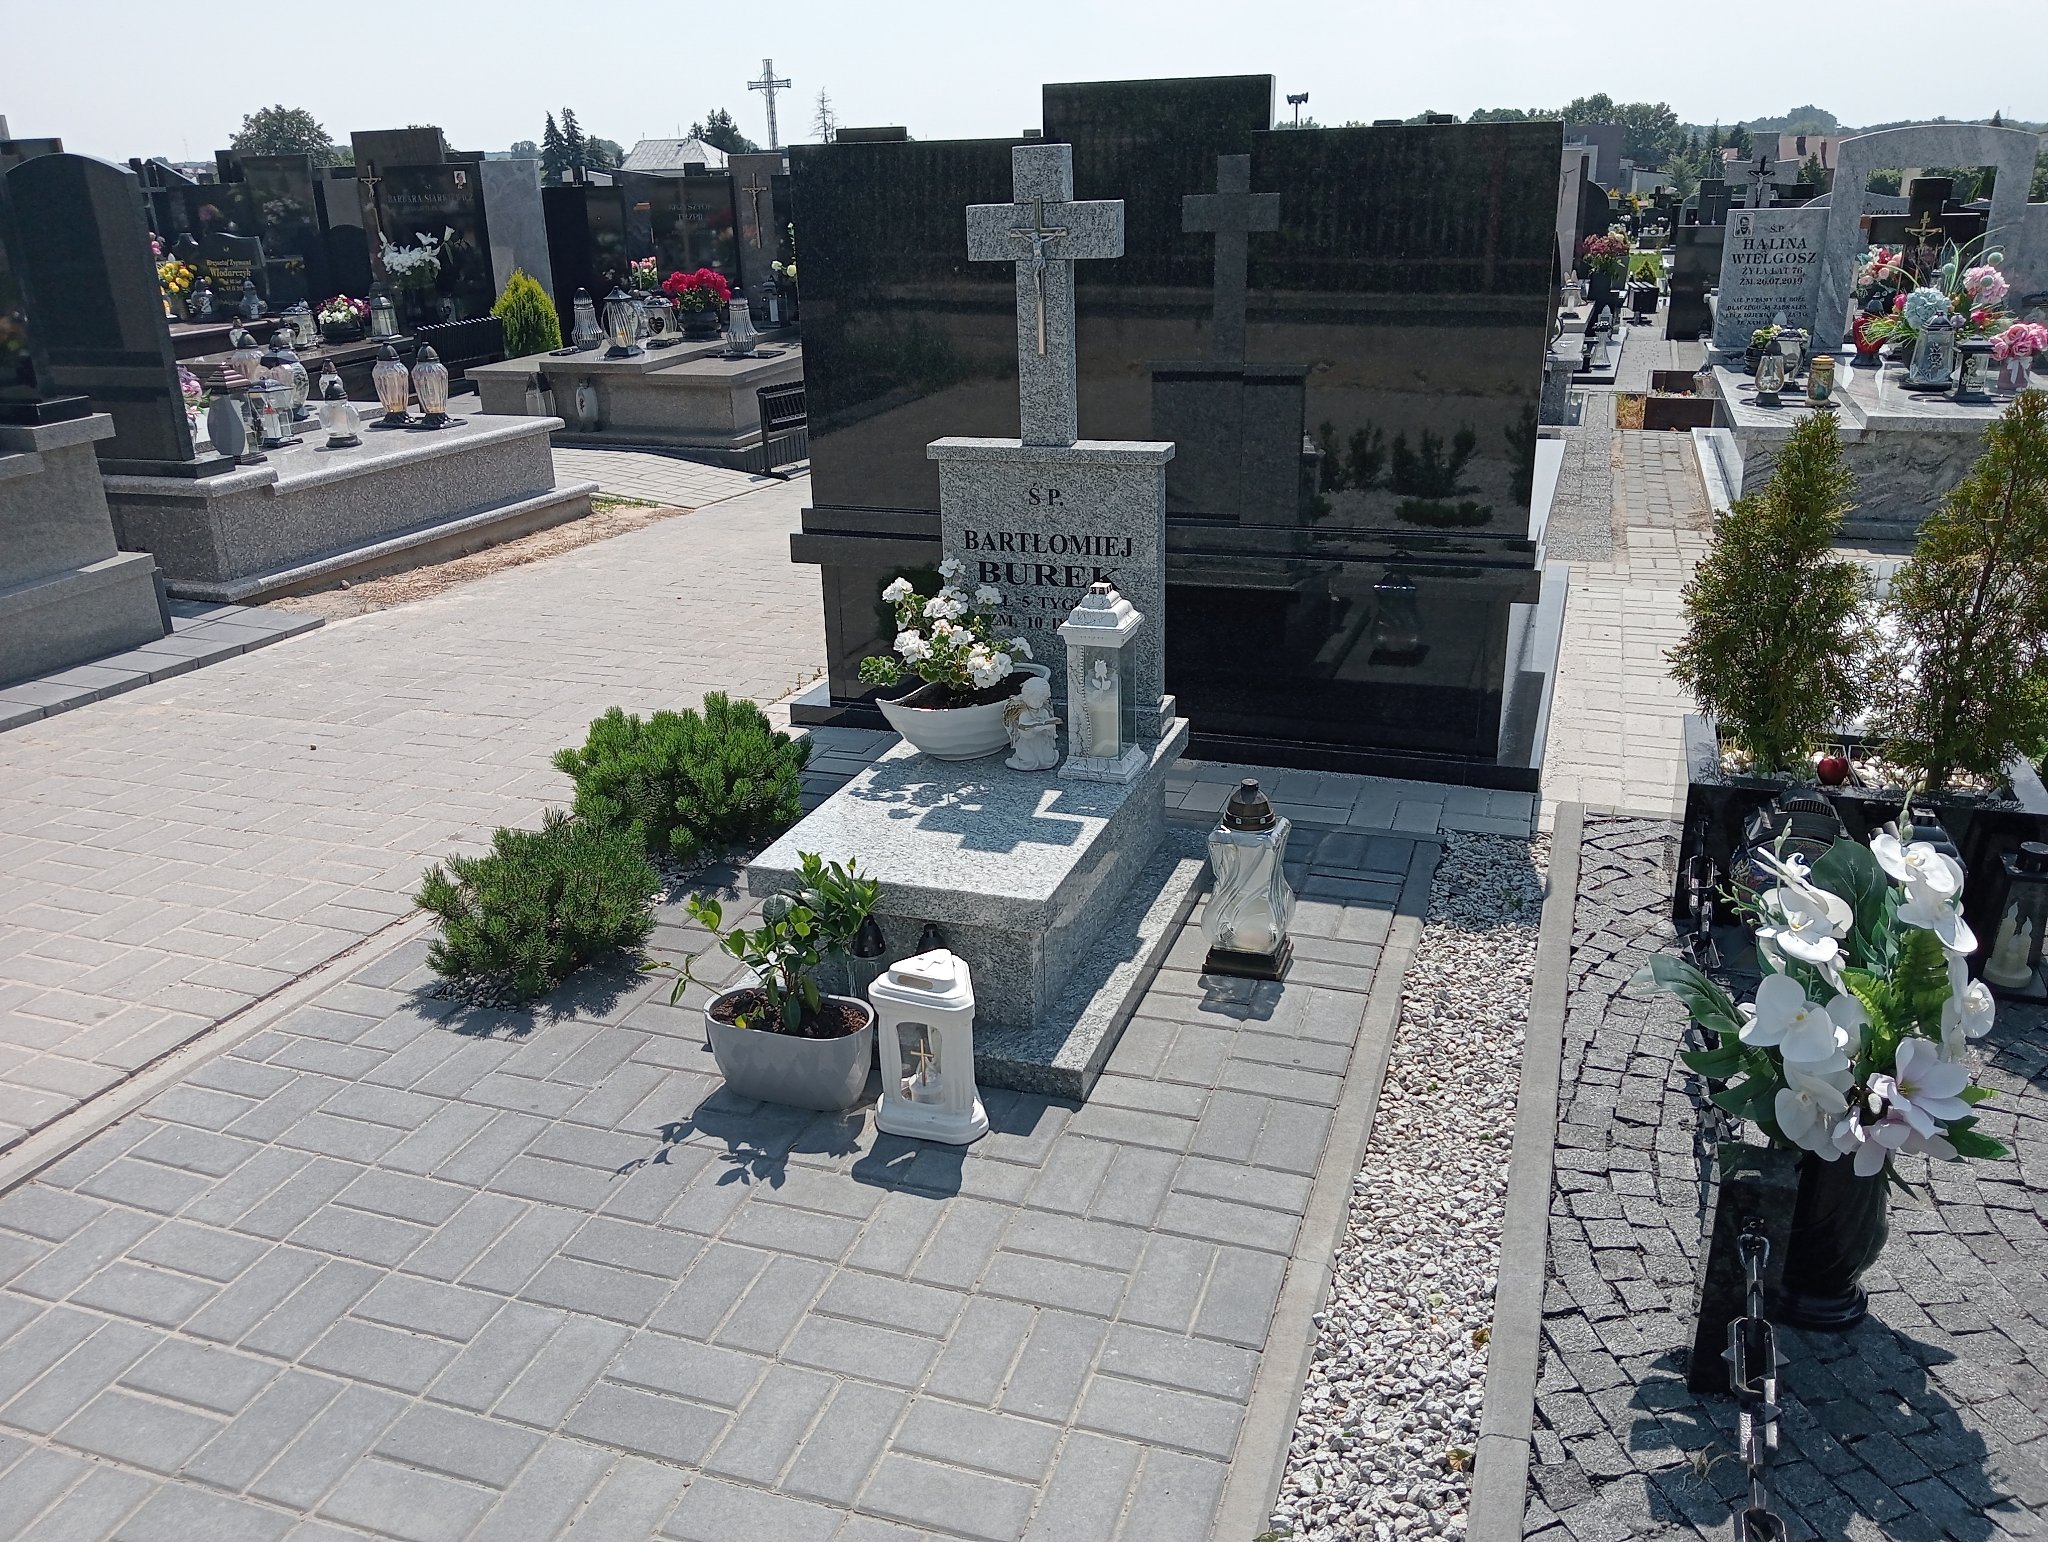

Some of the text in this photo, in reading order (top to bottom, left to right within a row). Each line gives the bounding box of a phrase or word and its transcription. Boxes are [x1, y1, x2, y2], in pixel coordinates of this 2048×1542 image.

[1743, 237, 1807, 250] HALINA
[1732, 252, 1817, 264] WIELGOSZ
[1769, 267, 1790, 275] LAT
[963, 530, 1133, 558] BARTŁOMIEJ
[977, 560, 1122, 591] BUREK
[1022, 595, 1030, 608] 5
[1027, 616, 1043, 629] 10
